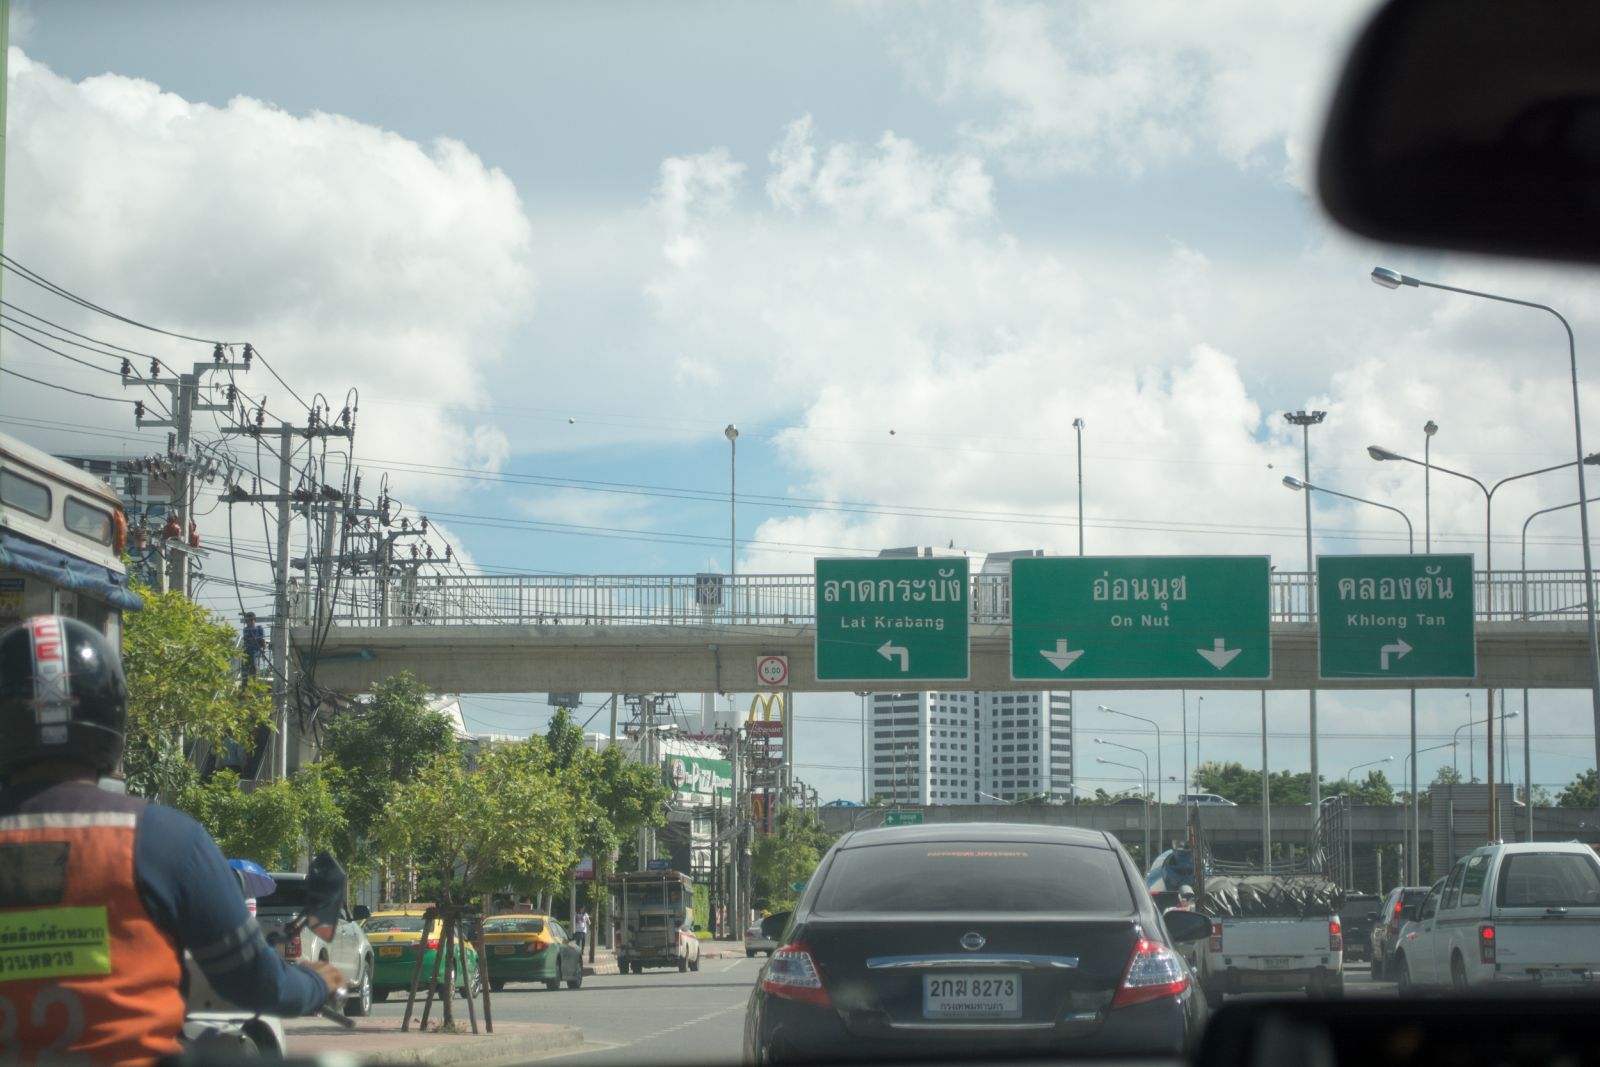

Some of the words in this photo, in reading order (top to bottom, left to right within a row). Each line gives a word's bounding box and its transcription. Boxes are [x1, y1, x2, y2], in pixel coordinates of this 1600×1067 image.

[823, 567, 961, 602] ลาดกระบัง
[1092, 570, 1187, 611] อ่อนนุช
[1337, 565, 1454, 601] คลองตัน
[841, 616, 866, 628] Lat
[875, 616, 945, 631] Krabang
[1111, 615, 1133, 627] On
[1142, 615, 1170, 627] Nut
[1347, 613, 1408, 629] Khlong
[1416, 613, 1446, 627] Tan
[764, 666, 781, 675] 5.00
[972, 979, 1014, 998] 8273
[940, 1002, 1004, 1011] กรงเทพมหานคร
